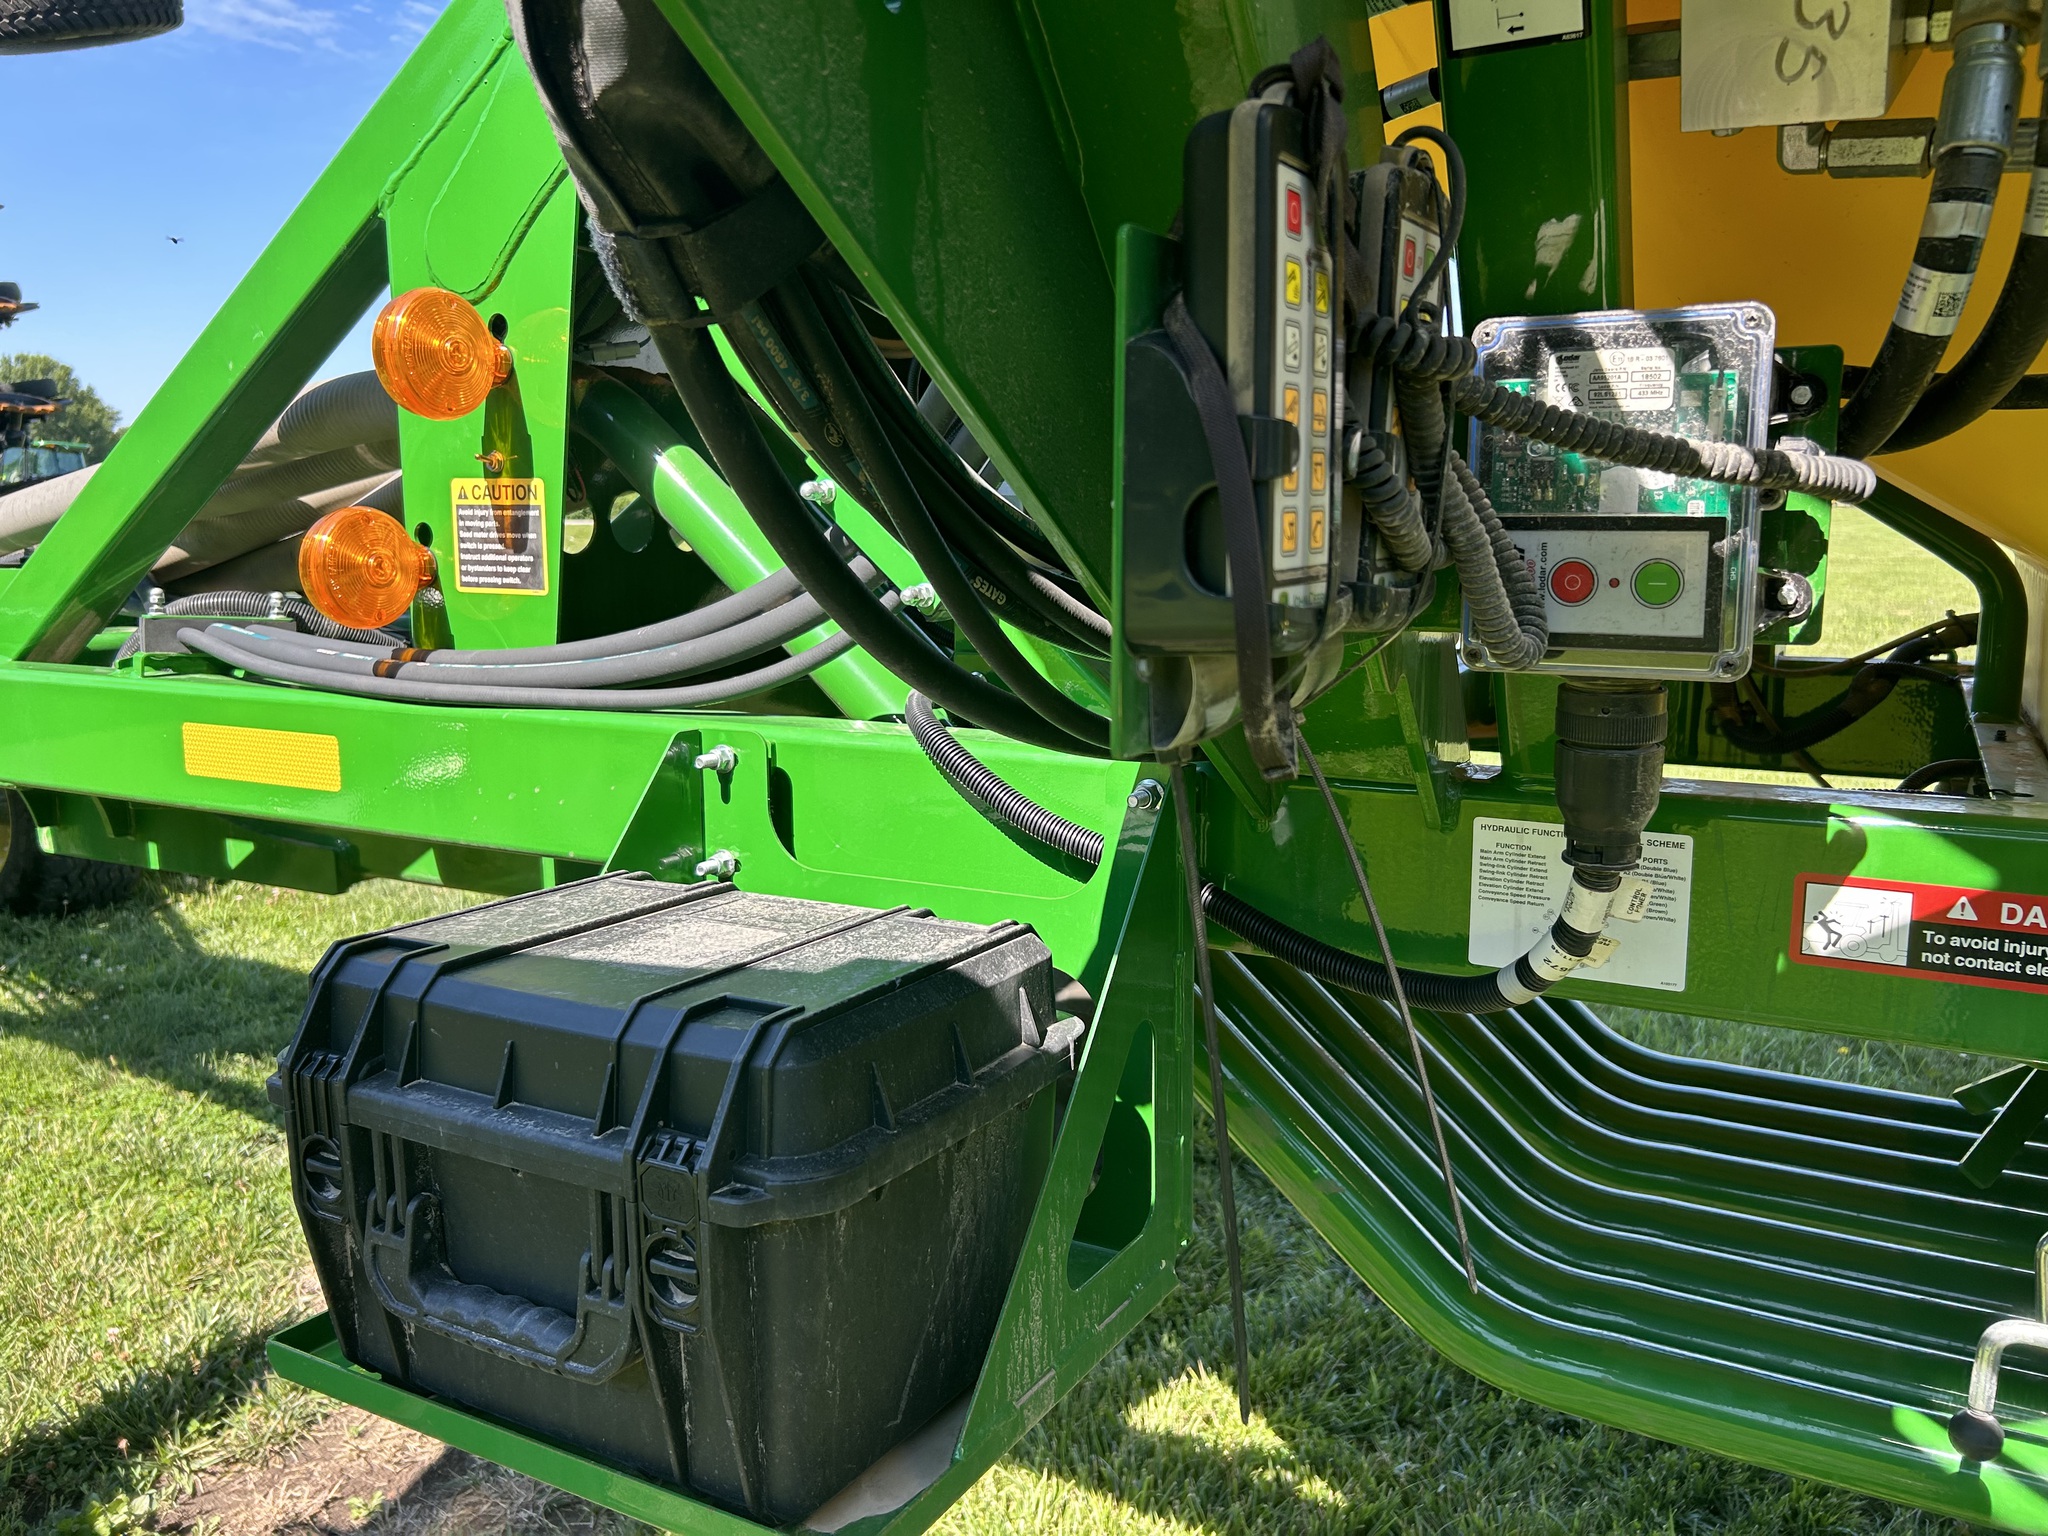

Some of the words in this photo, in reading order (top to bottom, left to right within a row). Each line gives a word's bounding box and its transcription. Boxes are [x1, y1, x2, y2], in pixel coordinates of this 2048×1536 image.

[765, 340, 788, 369] 4800
[472, 484, 538, 500] CAUTION
[503, 509, 540, 518] entanglement
[468, 565, 497, 573] bystanders
[504, 566, 516, 574] keep
[1538, 542, 1548, 601] w.lodar.com
[479, 576, 502, 585] pressing
[973, 576, 1006, 605] GATES
[1481, 824, 1530, 834] HYDRAULIC
[1496, 842, 1532, 851] FUNCTION
[1647, 839, 1686, 849] SCHEME
[1642, 857, 1668, 865] PORTS
[1478, 895, 1508, 903] Conveyance
[1627, 888, 1643, 915] CONTROL
[1635, 893, 1647, 913] POWER
[1921, 930, 1946, 946] To
[1949, 934, 1999, 952] avoid
[1921, 951, 1950, 966] not
[1954, 956, 2022, 974] contact
